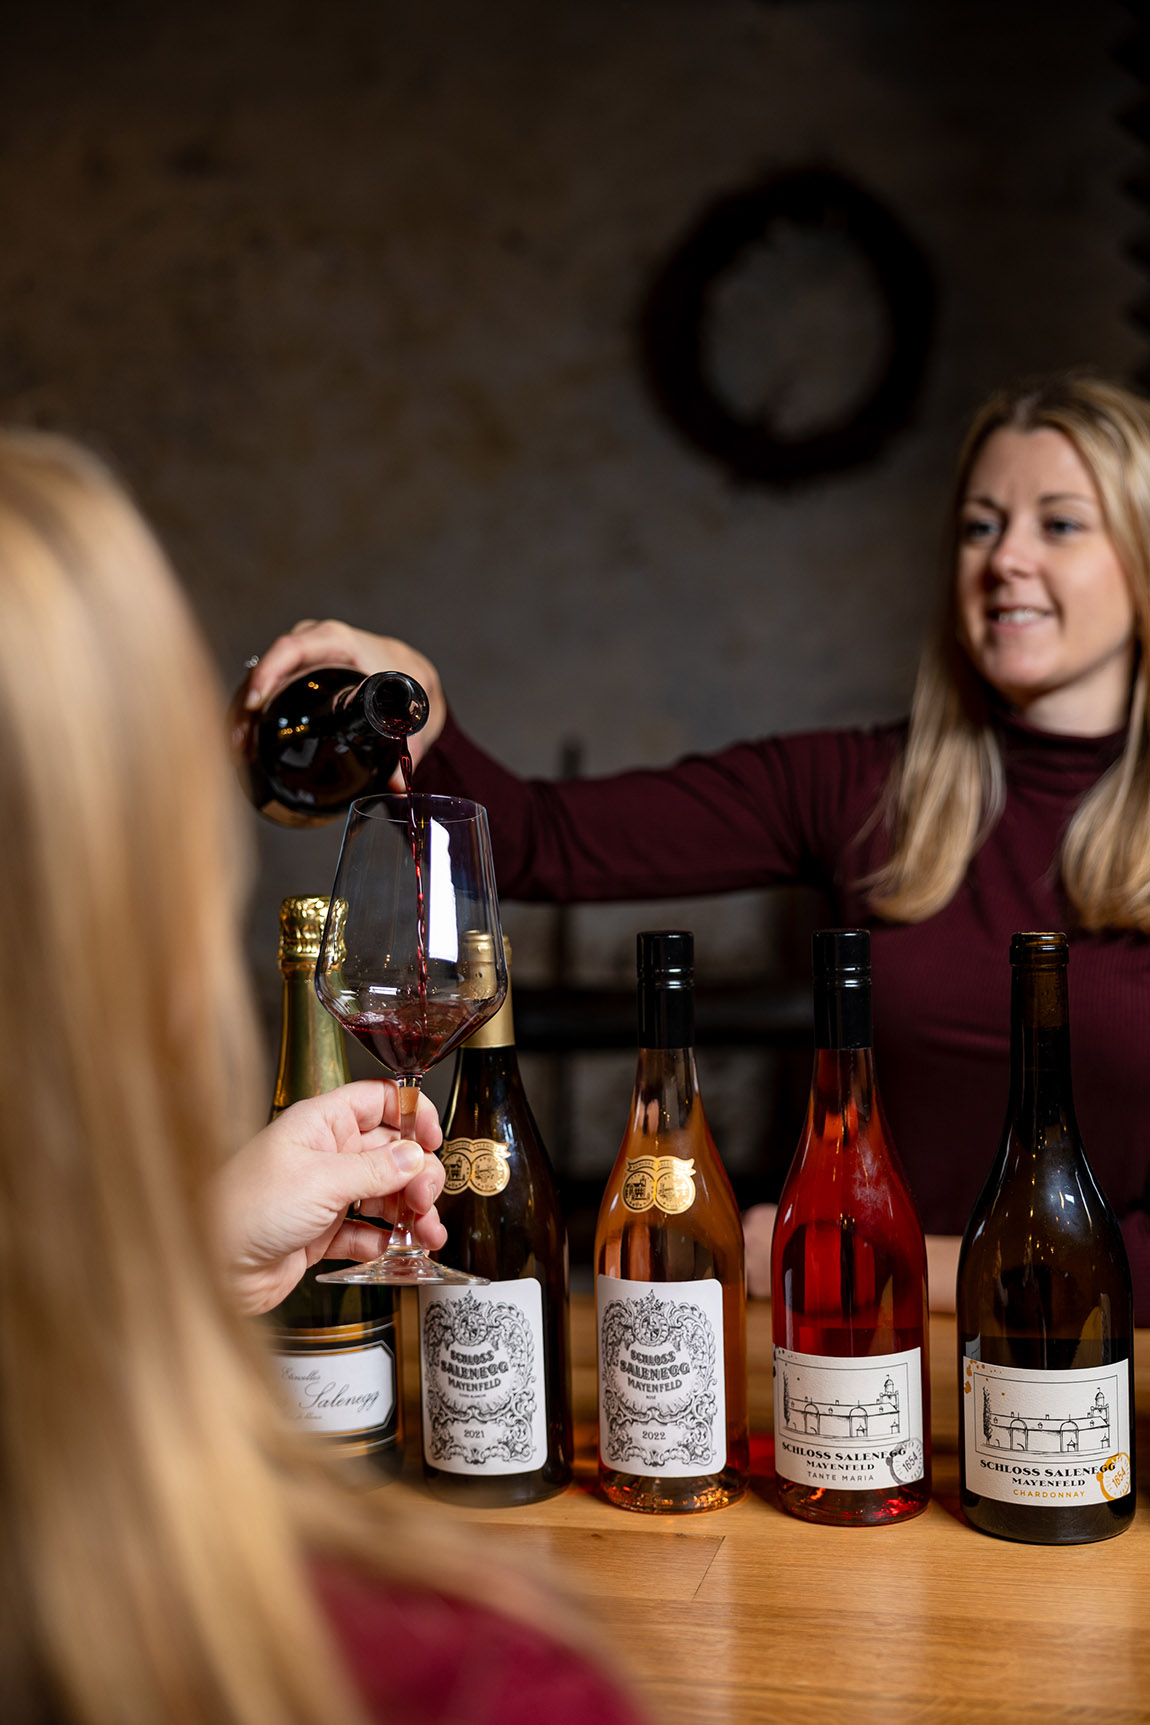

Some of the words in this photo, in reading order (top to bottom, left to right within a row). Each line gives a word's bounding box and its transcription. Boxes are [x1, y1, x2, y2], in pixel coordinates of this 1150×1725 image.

[450, 1350, 494, 1365] SCHLOSS
[631, 1350, 676, 1366] SCHLOSS
[440, 1360, 509, 1380] SALENEGG
[620, 1360, 690, 1380] SALENEGG
[447, 1376, 502, 1392] MAYENFELD
[628, 1377, 682, 1392] MAYENFELD
[298, 1381, 380, 1413] Salenegg
[463, 1428, 485, 1439] 2021
[642, 1430, 667, 1441] 2022
[782, 1442, 831, 1460] SCHLOSS
[835, 1448, 906, 1461] SALENEGG
[806, 1460, 875, 1470] MAYENFELD
[902, 1451, 918, 1472] 1654
[980, 1459, 1040, 1476] SCHLOSS
[1044, 1463, 1116, 1477] SALENEGG
[807, 1471, 837, 1481] TANTE
[841, 1474, 874, 1482] MARIA
[1012, 1477, 1085, 1487] MAYENFELD
[1112, 1466, 1126, 1488] 1654
[1013, 1488, 1085, 1498] CHARDONNAY
